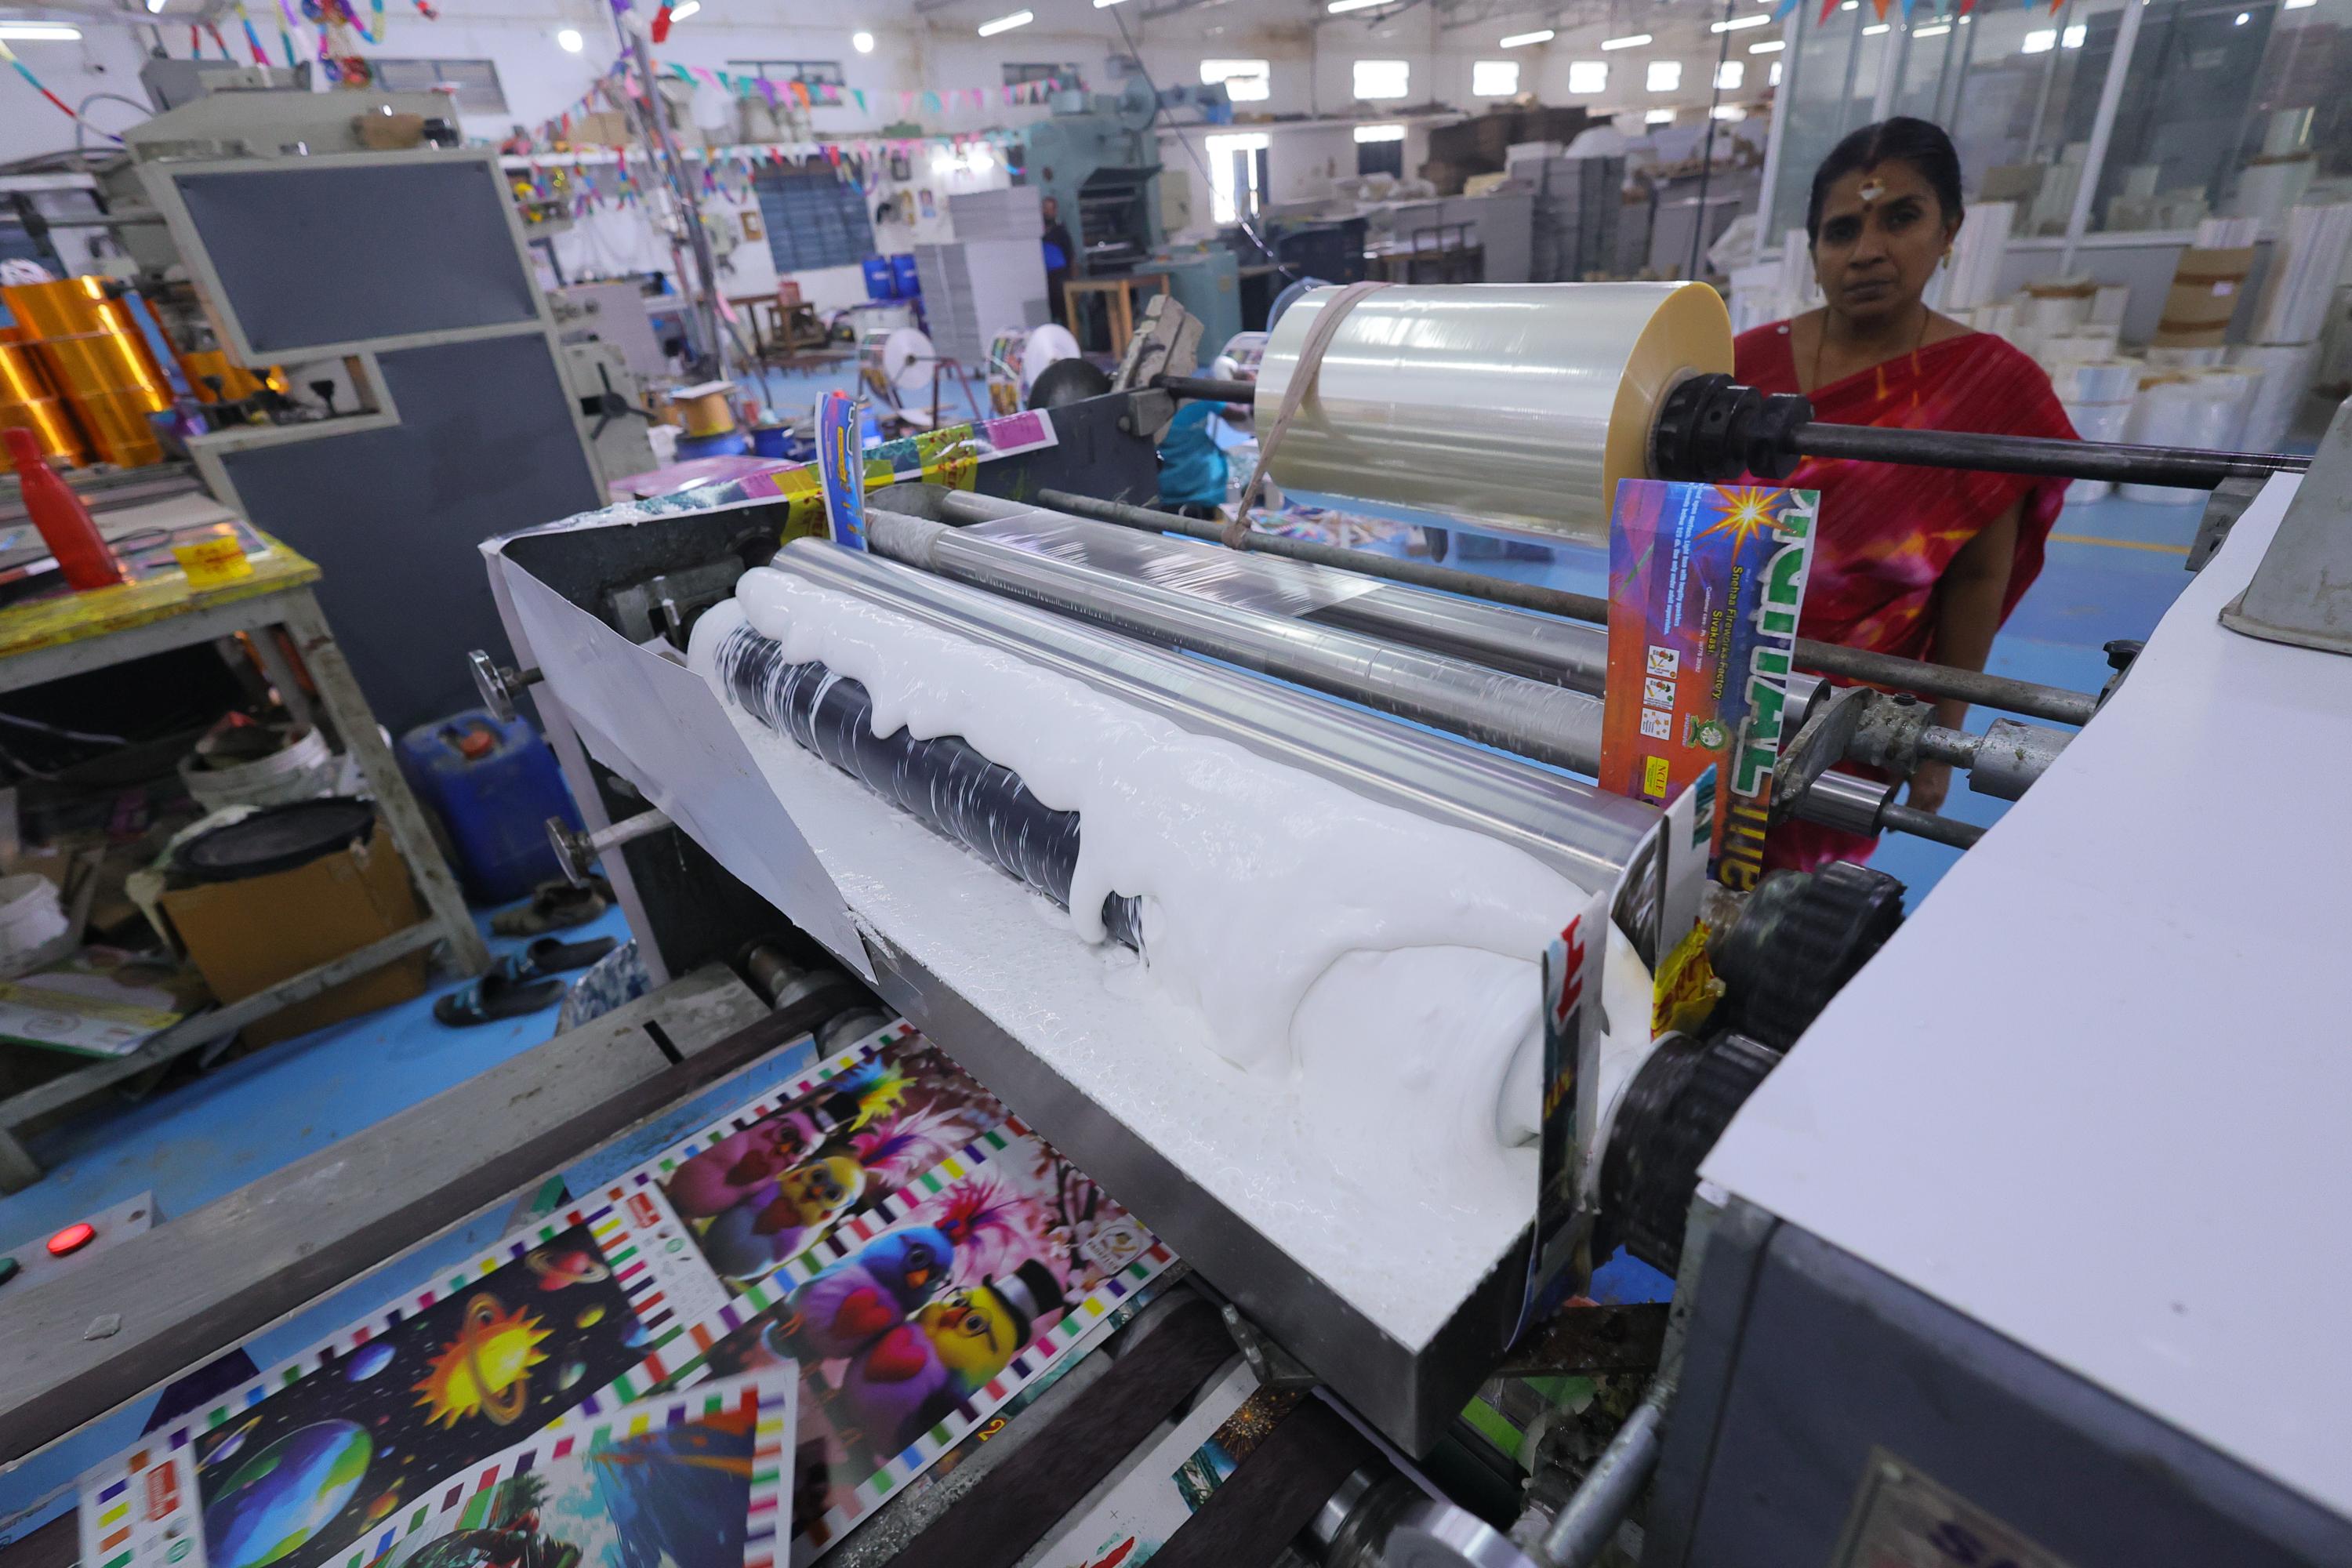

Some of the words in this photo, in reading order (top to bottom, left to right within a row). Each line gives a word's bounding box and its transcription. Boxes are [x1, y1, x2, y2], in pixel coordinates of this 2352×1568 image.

[1704, 586, 1713, 612] Customer
[1728, 566, 1744, 605] Snehaa
[1720, 608, 1737, 659] Fireworks
[1655, 764, 1667, 792] NCLE
